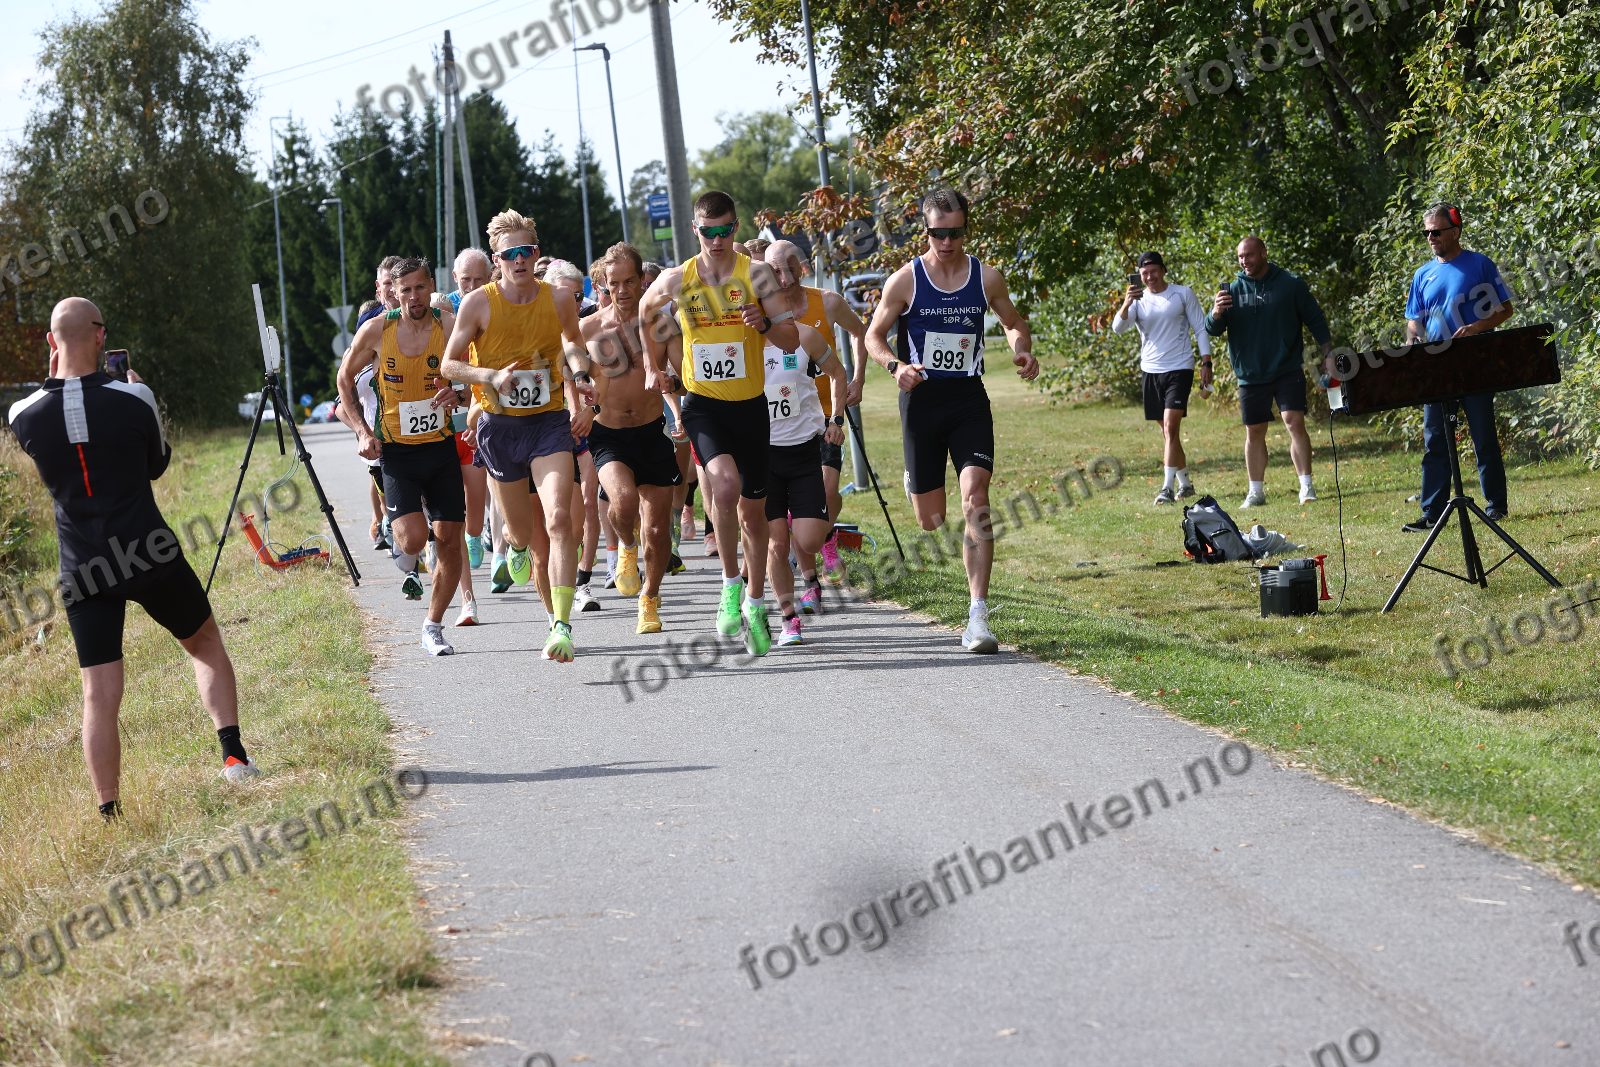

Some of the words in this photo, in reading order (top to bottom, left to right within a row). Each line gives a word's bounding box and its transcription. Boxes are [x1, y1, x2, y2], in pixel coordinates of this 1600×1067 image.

[919, 306, 982, 316] SPAREBANKEN
[943, 316, 961, 324] SØR
[703, 359, 736, 380] 942
[932, 349, 965, 370] 993
[508, 386, 541, 407] 992
[769, 399, 791, 419] 76
[410, 412, 439, 433] 252
